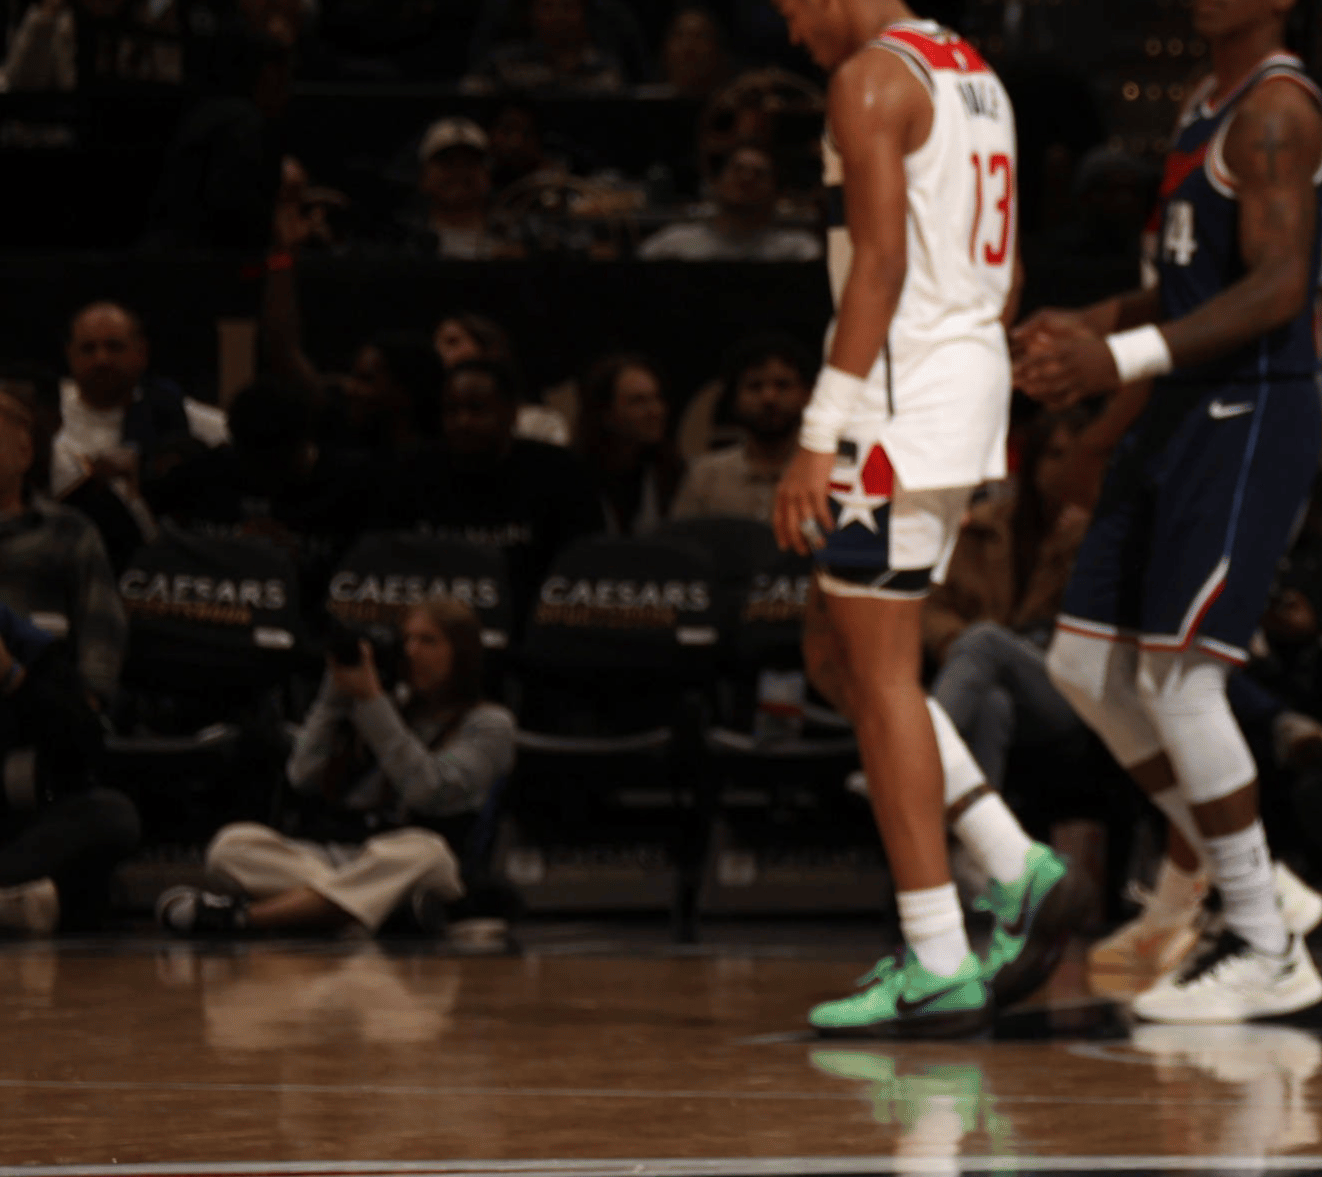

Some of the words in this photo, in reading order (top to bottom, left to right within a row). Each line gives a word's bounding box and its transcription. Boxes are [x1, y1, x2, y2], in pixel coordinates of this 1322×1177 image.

[969, 152, 1011, 265] 13
[119, 568, 286, 610] CAESARS
[329, 570, 498, 609] CAESARS
[540, 574, 710, 612] CAESARS
